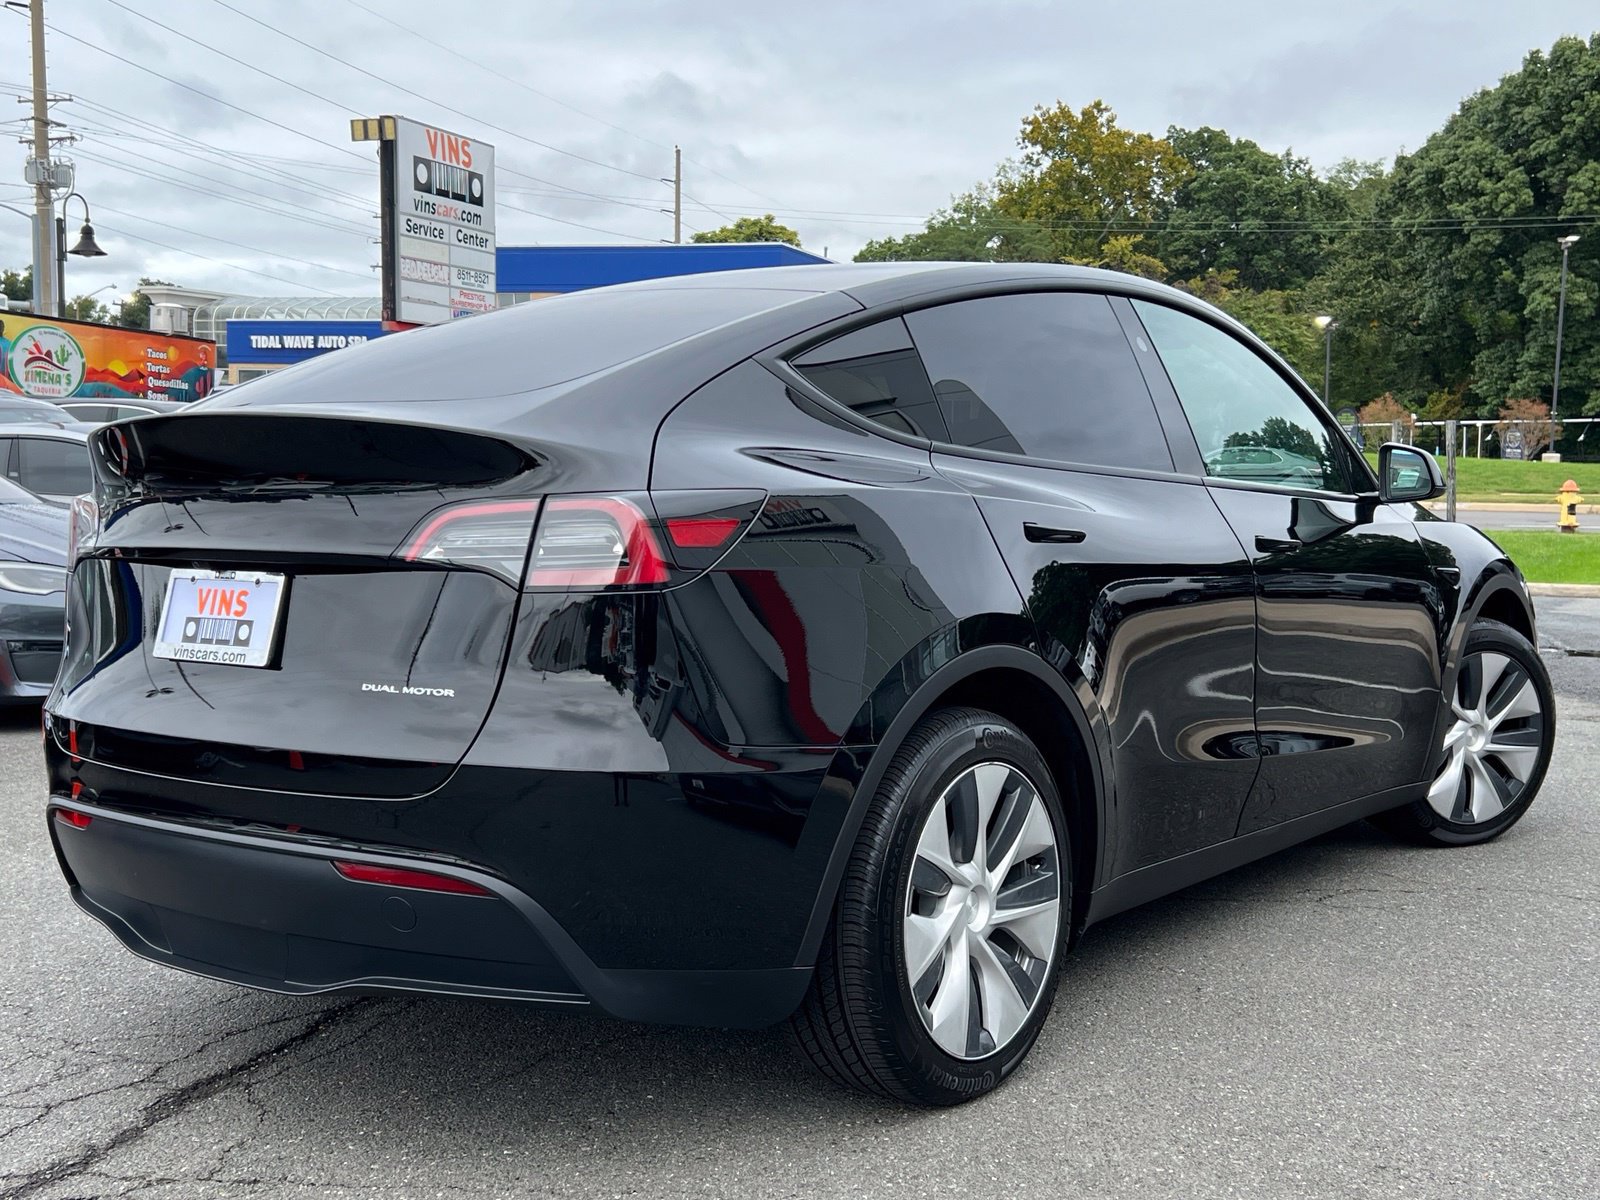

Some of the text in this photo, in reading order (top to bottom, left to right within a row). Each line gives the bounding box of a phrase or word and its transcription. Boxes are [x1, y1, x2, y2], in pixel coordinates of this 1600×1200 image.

[426, 129, 472, 168] VINS
[413, 195, 482, 226] vinscars.com
[405, 218, 489, 248] Service Center
[457, 269, 489, 285] 8511-8521
[459, 290, 486, 302] PRESTIGE
[250, 335, 282, 349] TIDAL
[282, 335, 315, 349] WAVE
[317, 335, 346, 348] AUTO
[146, 348, 168, 359] Tacos
[146, 362, 171, 374] Tortas
[24, 370, 72, 386] XIMENA'S
[147, 376, 189, 390] Quesadillas
[33, 386, 61, 395] TAQUERIA
[197, 588, 250, 617] VINS
[173, 645, 247, 663] vinscars.com
[361, 683, 455, 697] DUAL MOTOR
